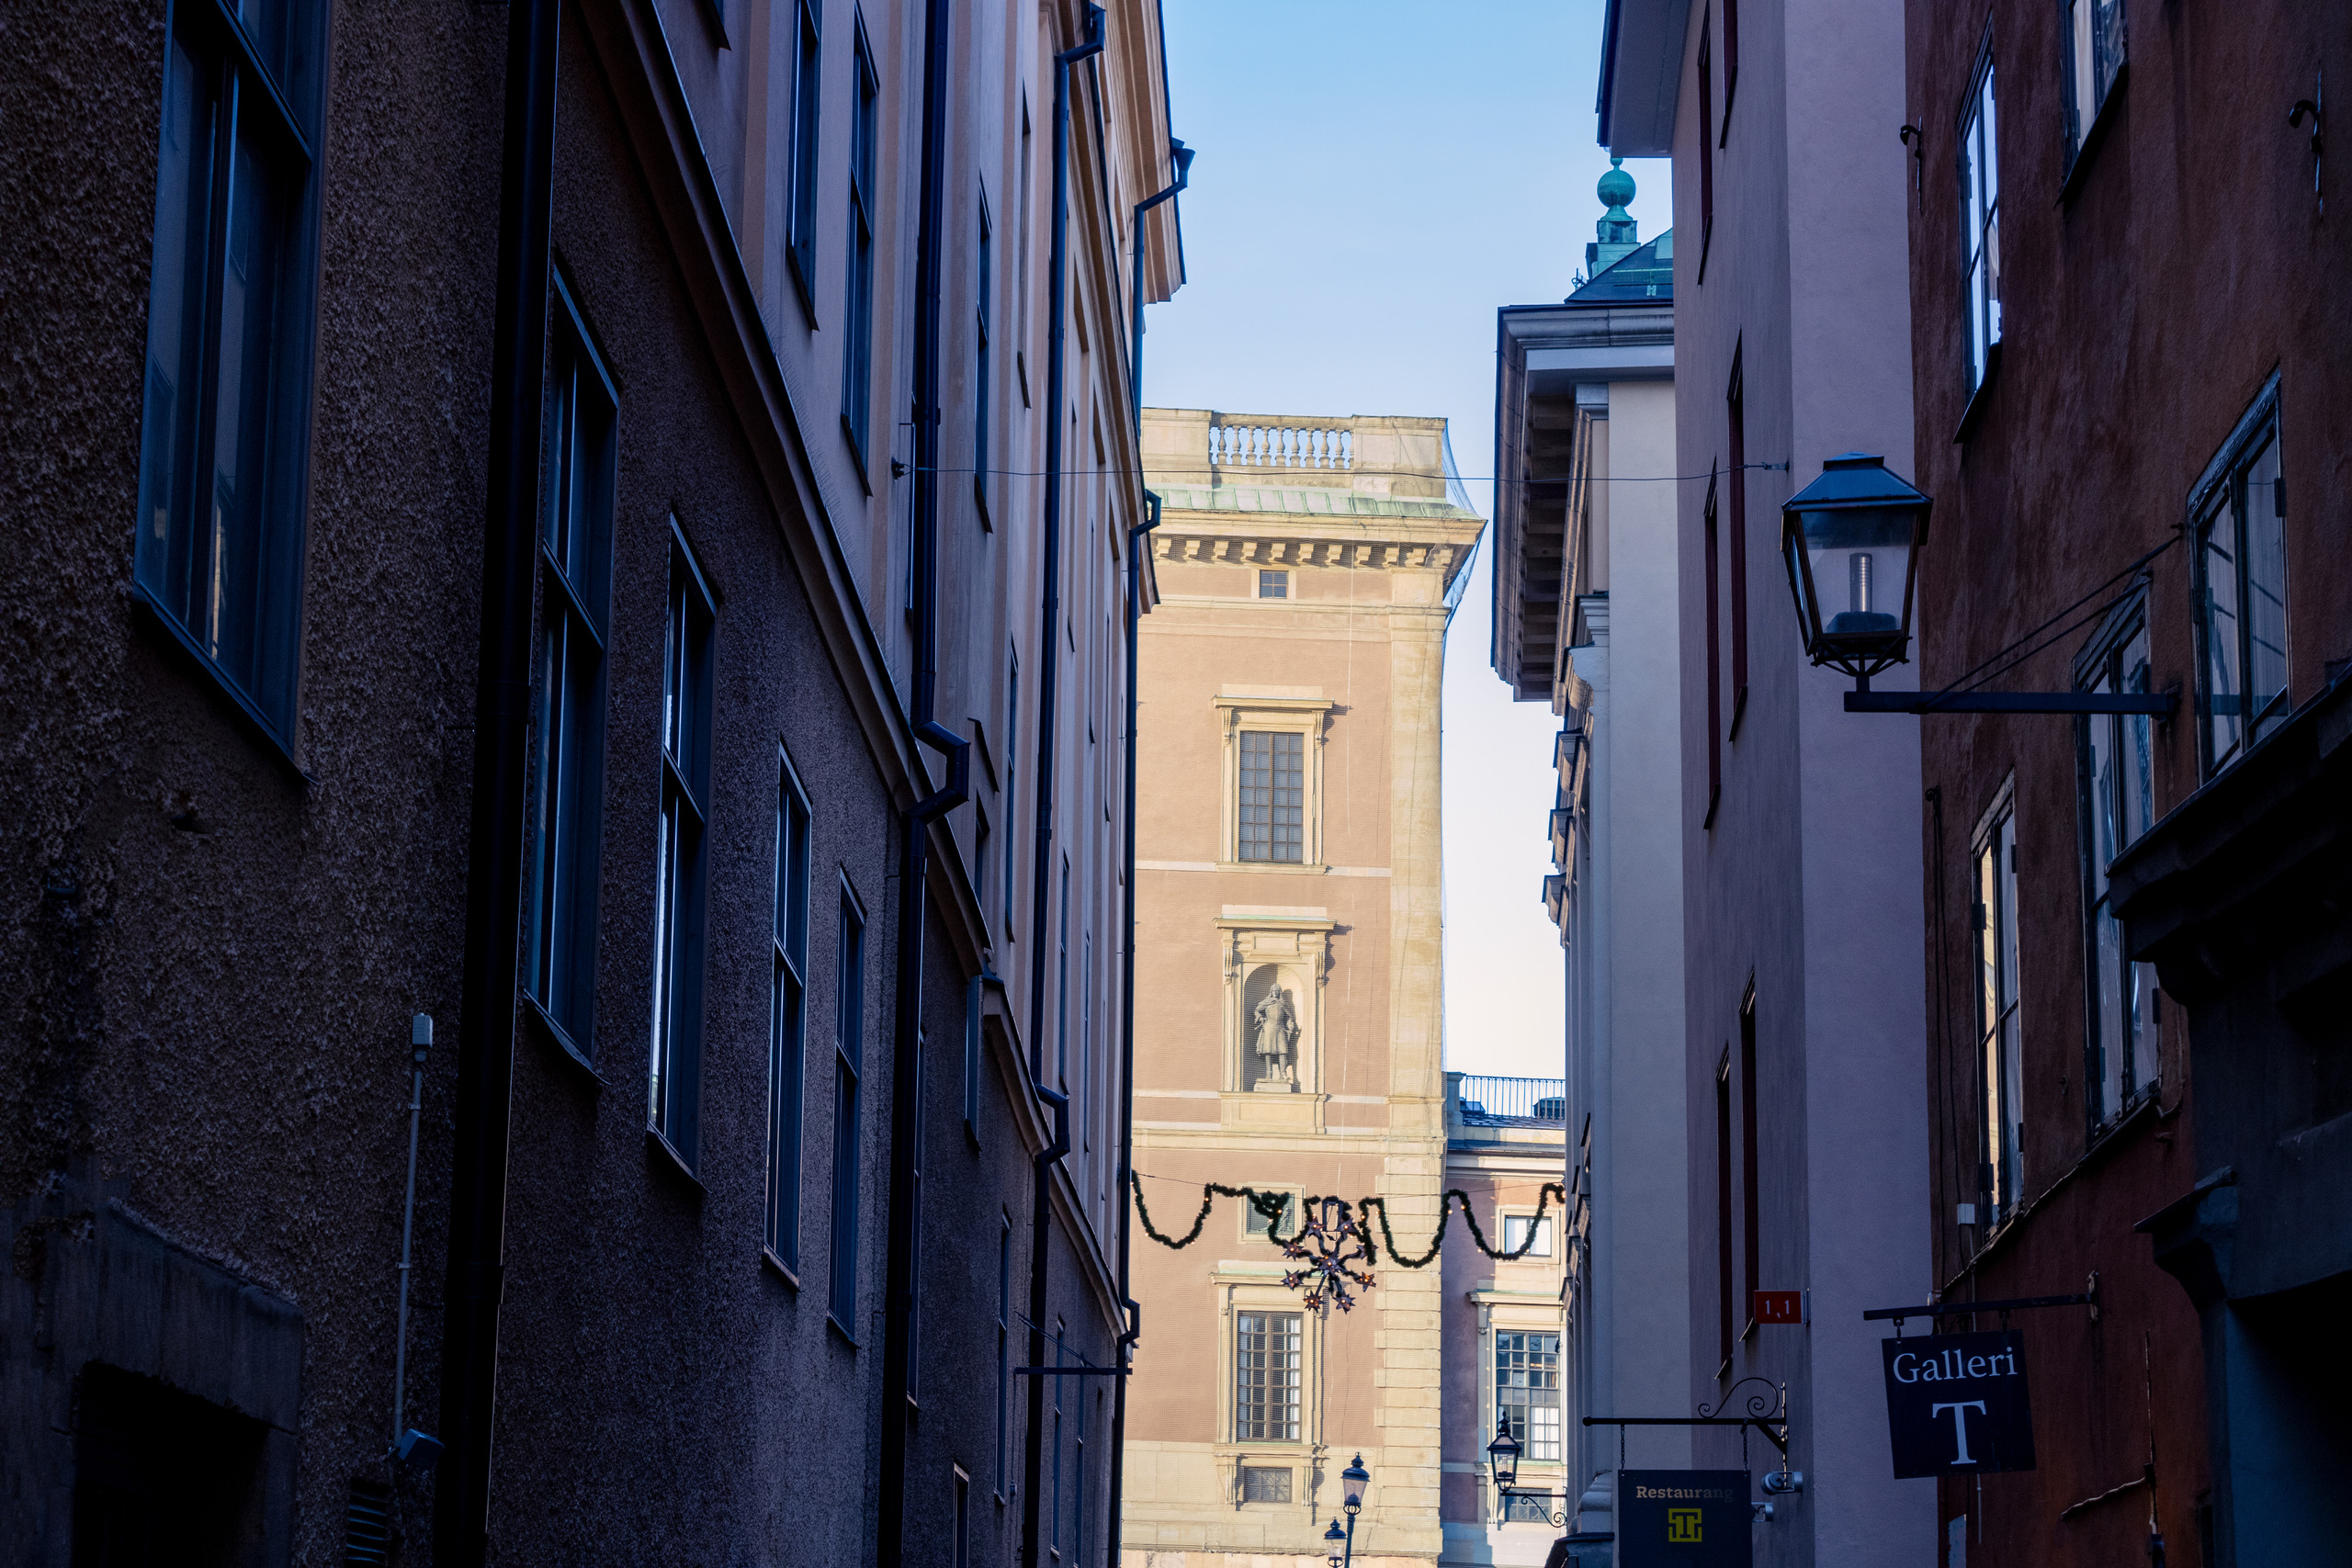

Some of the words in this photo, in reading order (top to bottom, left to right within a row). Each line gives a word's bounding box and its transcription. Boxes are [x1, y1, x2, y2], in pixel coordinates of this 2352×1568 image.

[1893, 1346, 2018, 1383] Galleri
[1932, 1400, 1987, 1465] T
[1635, 1485, 1734, 1503] Restaurang
